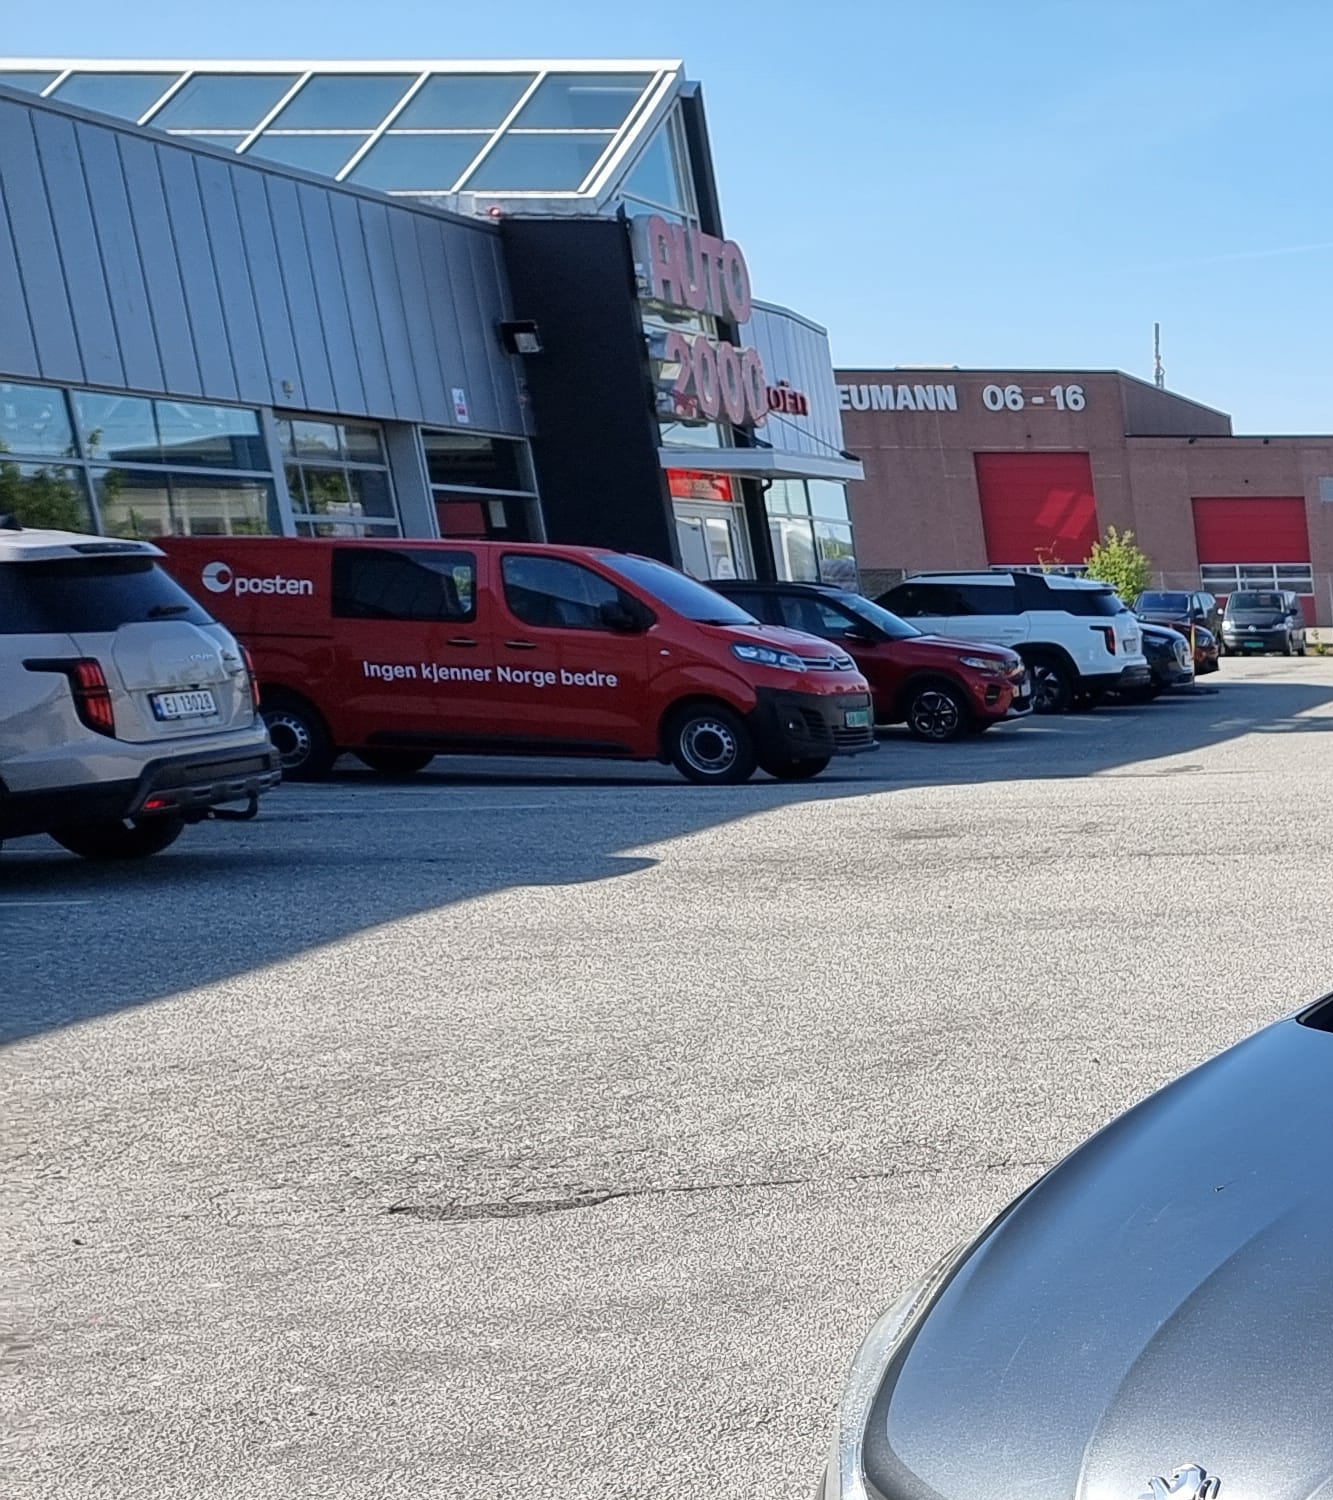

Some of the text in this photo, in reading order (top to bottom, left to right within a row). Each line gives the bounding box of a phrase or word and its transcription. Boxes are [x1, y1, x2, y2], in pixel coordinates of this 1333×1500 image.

[642, 213, 752, 325] AUTO
[660, 330, 770, 428] 2000
[983, 384, 1025, 411] 06
[1050, 384, 1086, 411] 16
[234, 574, 314, 597] posten
[363, 660, 618, 688] Ingen kjenner Norge bedre
